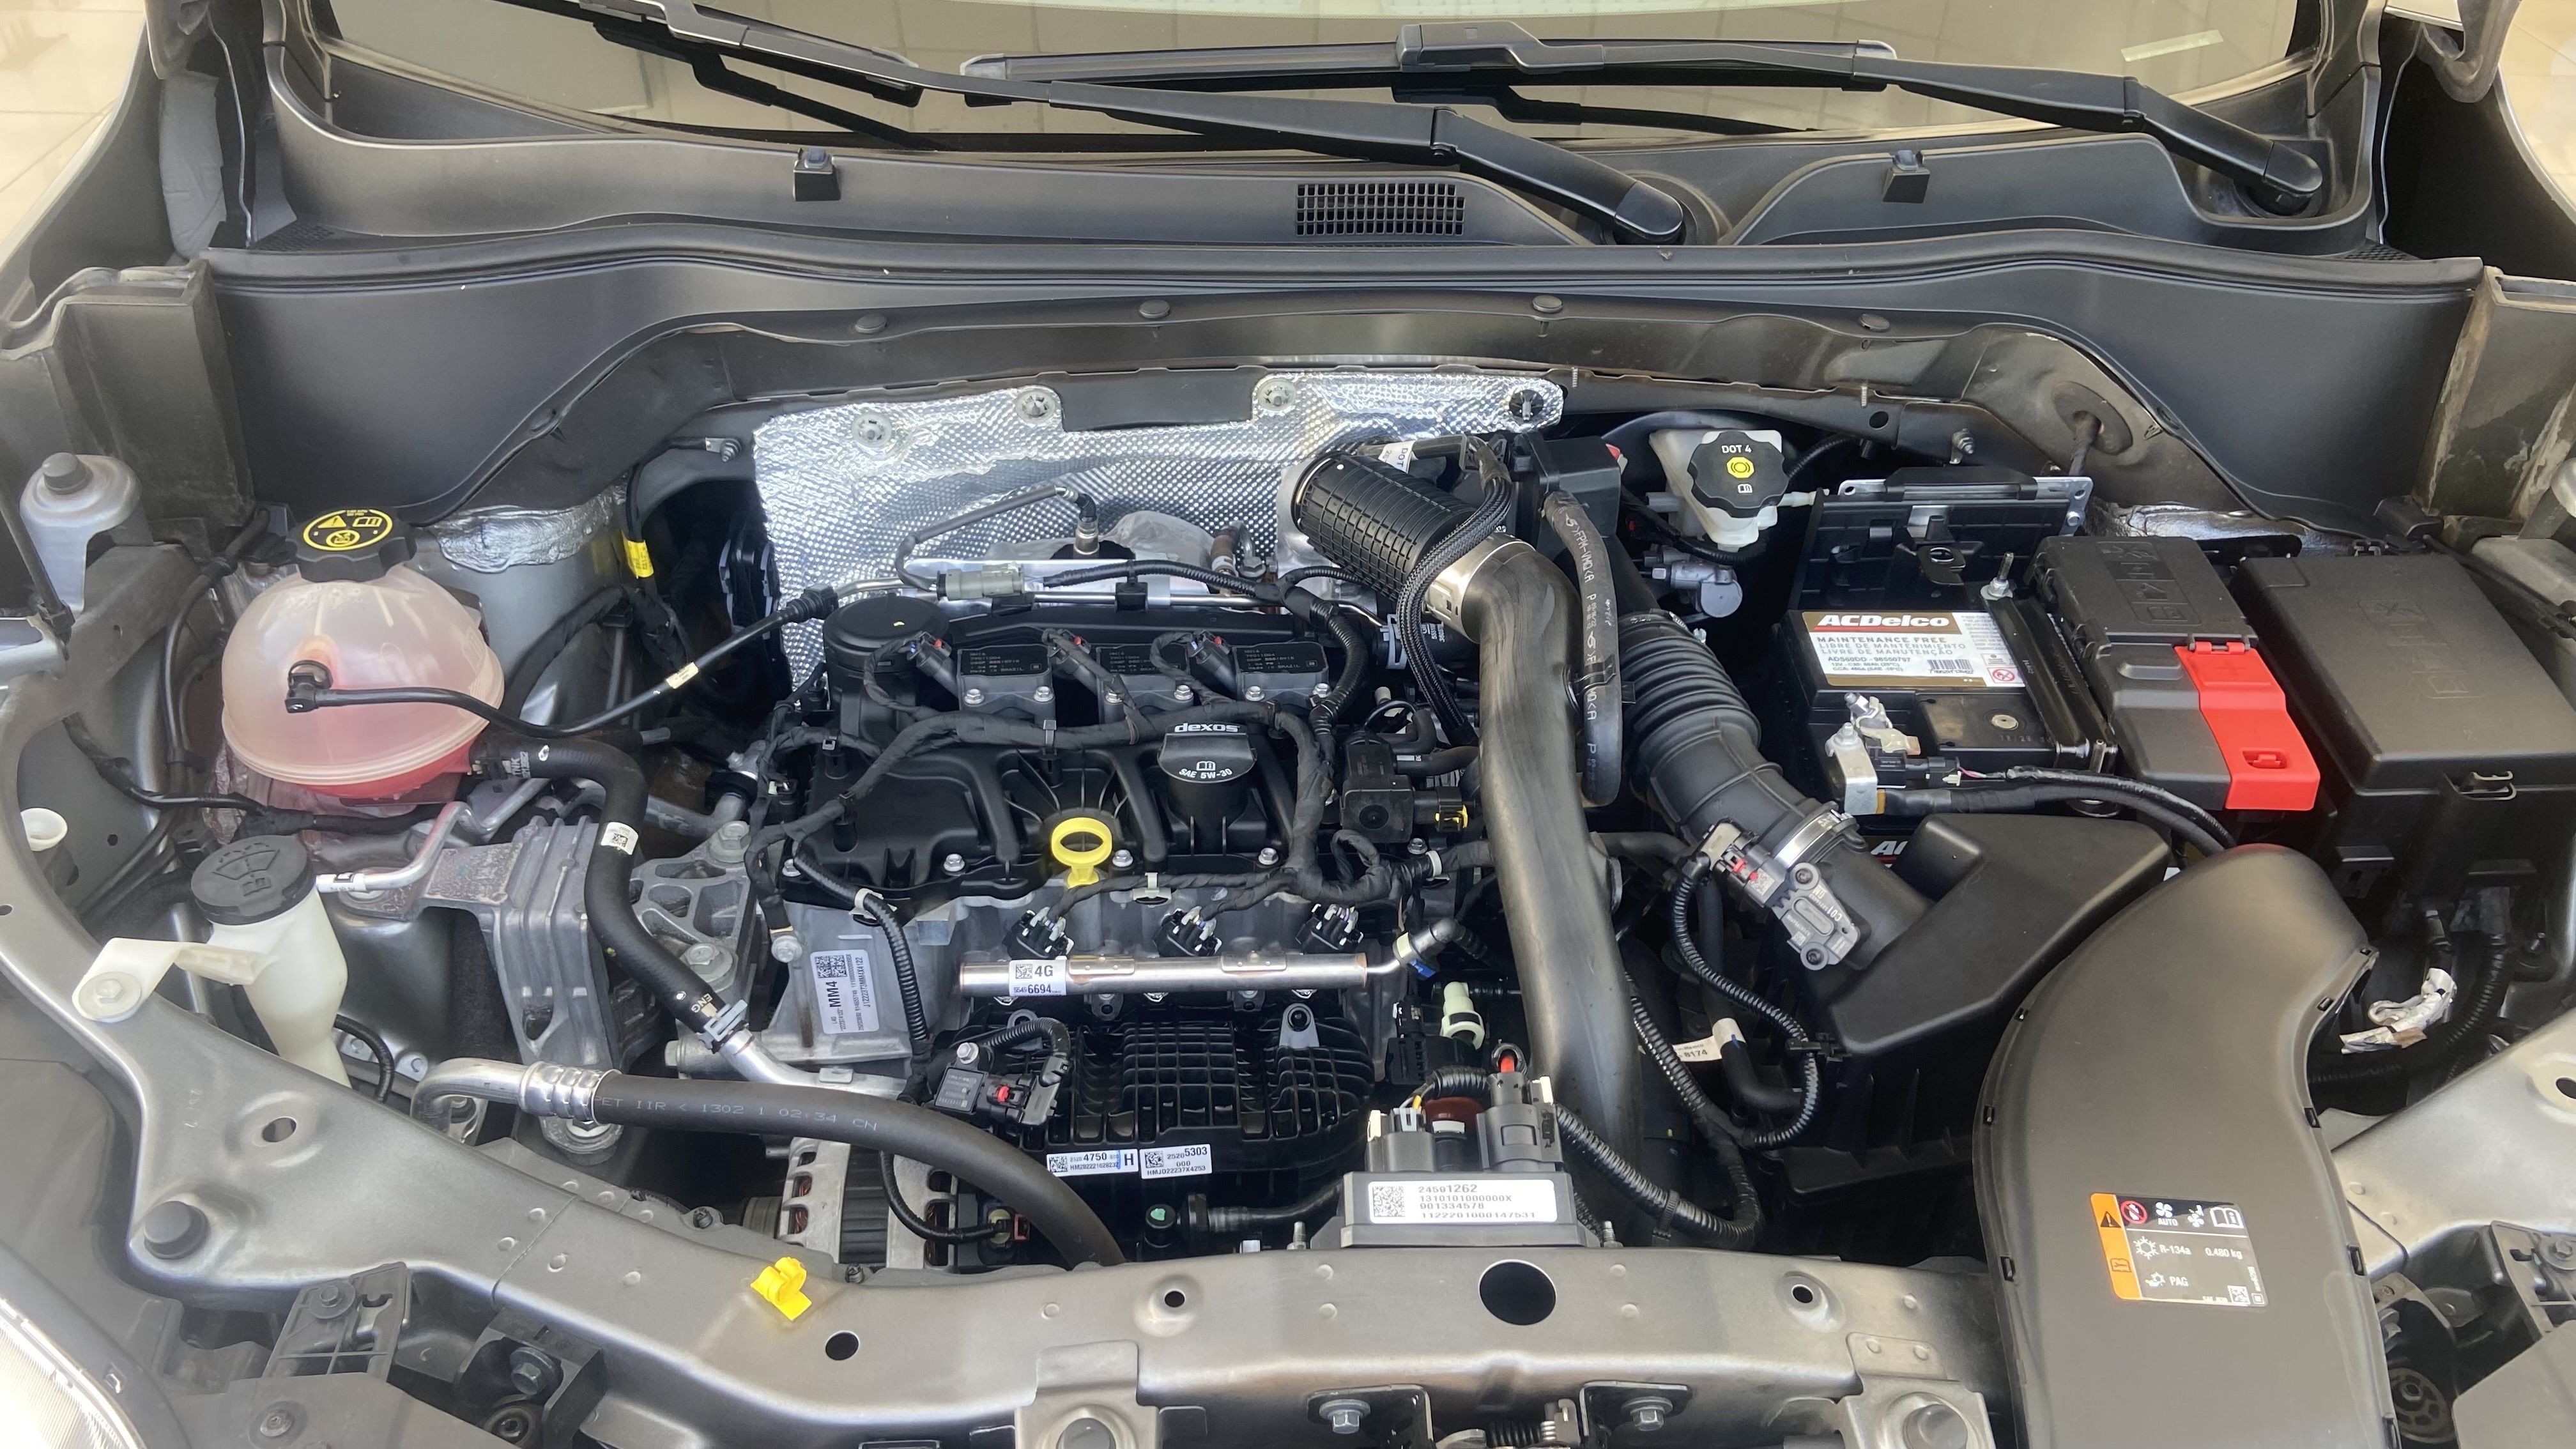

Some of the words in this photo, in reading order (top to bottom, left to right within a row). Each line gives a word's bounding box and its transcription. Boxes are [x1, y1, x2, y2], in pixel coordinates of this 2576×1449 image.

[1721, 445, 1742, 453] DOT
[1745, 444, 1752, 453] 4
[1397, 448, 1408, 467] DOT
[1817, 614, 1950, 627] ACDelco
[1174, 723, 1238, 733] dexos
[1179, 768, 1198, 778] SAE
[1200, 768, 1233, 779] 5W-30
[1035, 965, 1054, 977] 4G
[825, 981, 841, 1008] MM4
[691, 993, 713, 1013] ENG
[702, 1104, 744, 1115] 1302
[852, 1118, 877, 1131] CN
[1084, 1152, 1107, 1162] 4750
[1124, 1153, 1134, 1166] H
[2159, 1245, 2191, 1255] R-134a
[2205, 1248, 2229, 1257] 0.480
[2230, 1248, 2243, 1260] kg
[2170, 1276, 2189, 1287] PAG
